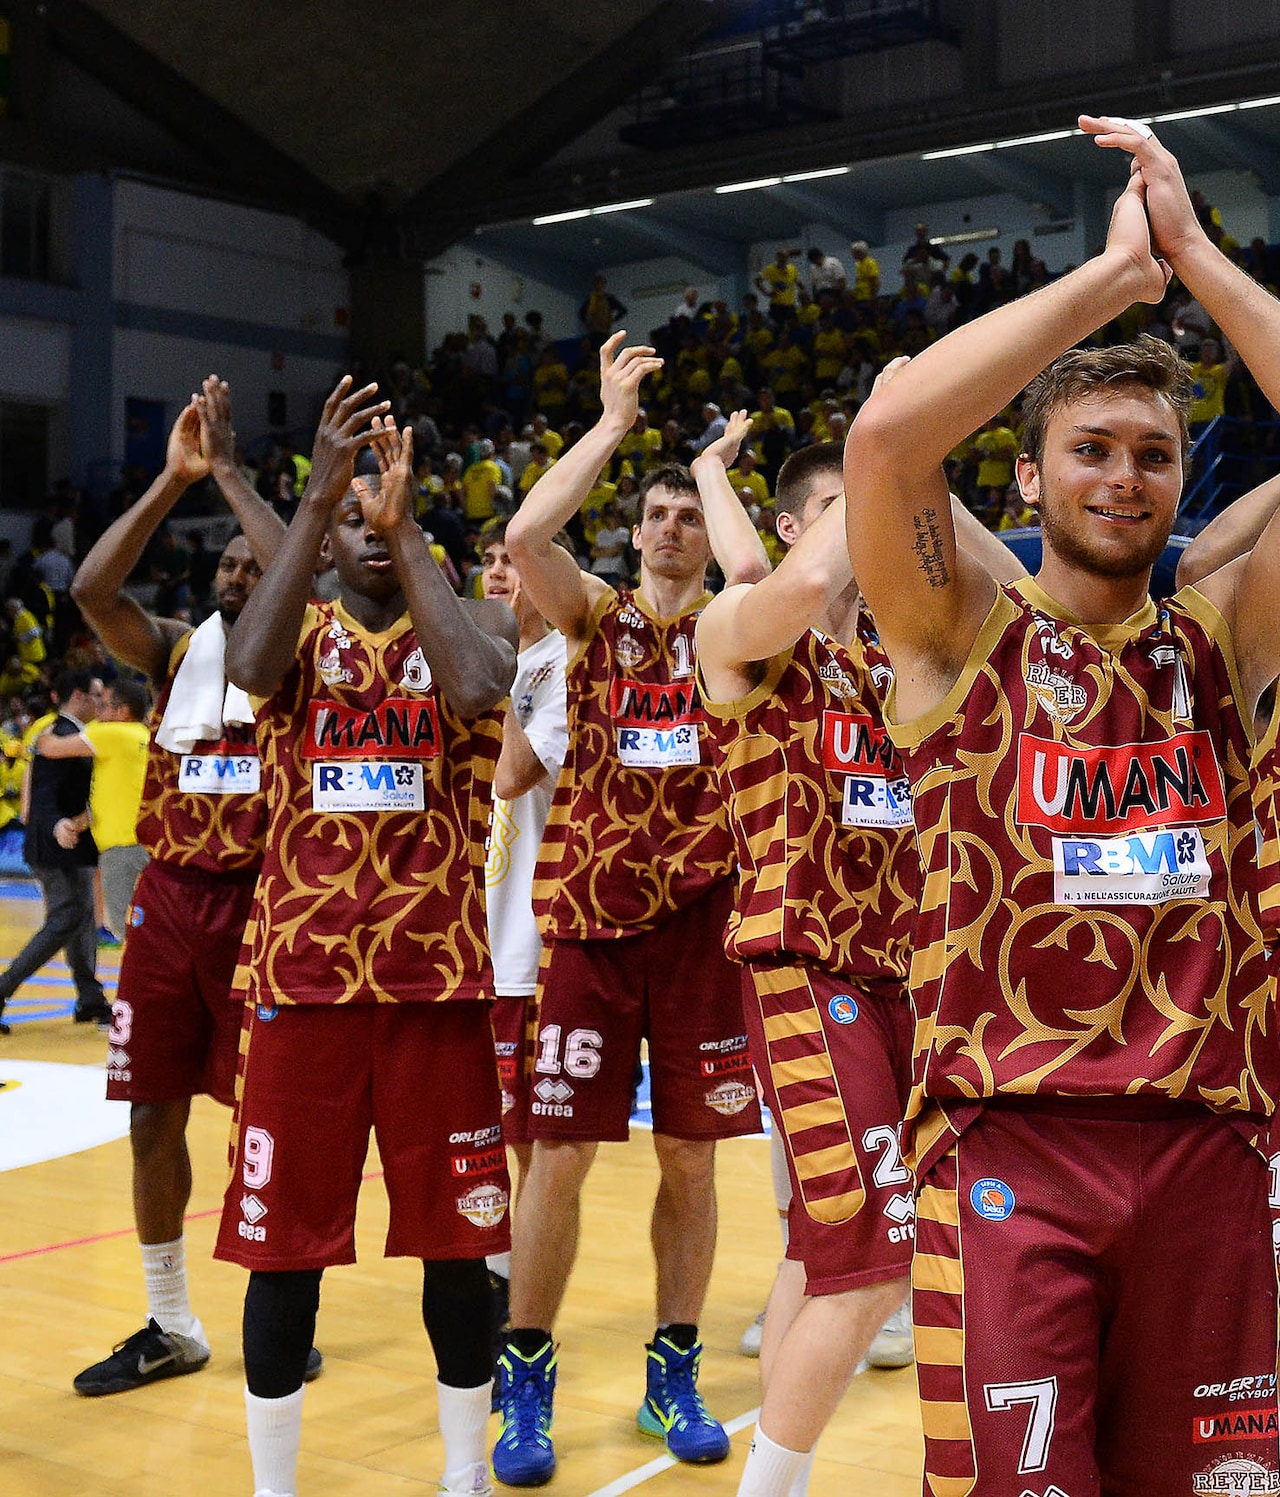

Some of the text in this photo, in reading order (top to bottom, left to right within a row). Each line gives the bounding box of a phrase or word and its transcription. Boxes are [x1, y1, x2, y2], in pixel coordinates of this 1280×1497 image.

[671, 633, 697, 679] 1
[1033, 747, 1208, 821] UMANA
[1062, 832, 1179, 876] RBM
[1162, 873, 1201, 887] Salute
[1170, 886, 1197, 897] SALUTE
[109, 999, 134, 1046] 3
[535, 1024, 603, 1078] 16
[531, 1102, 573, 1118] errea
[242, 1125, 275, 1190] 9
[862, 1122, 910, 1188] 2
[238, 1221, 267, 1242] eea
[887, 1223, 914, 1244] err
[1193, 1373, 1278, 1398] ORLERTV
[1228, 1388, 1276, 1402] SKY907
[983, 1375, 1059, 1476] 7
[1199, 1412, 1279, 1438] UMANA
[1193, 1471, 1280, 1491] REYER
